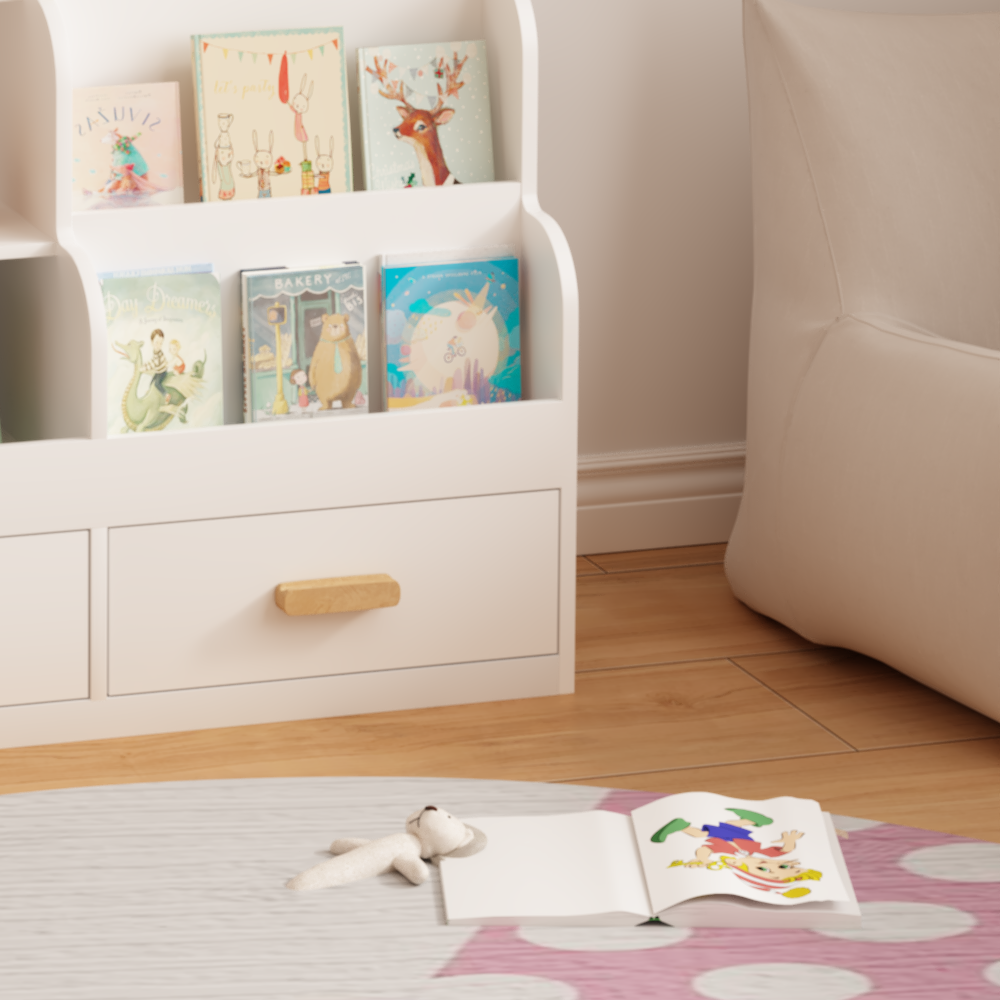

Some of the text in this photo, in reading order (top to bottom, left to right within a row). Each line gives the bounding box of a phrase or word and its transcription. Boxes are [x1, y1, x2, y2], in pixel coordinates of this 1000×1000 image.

[273, 273, 333, 290] BAKERY
[103, 280, 217, 323] Day Dreamers
